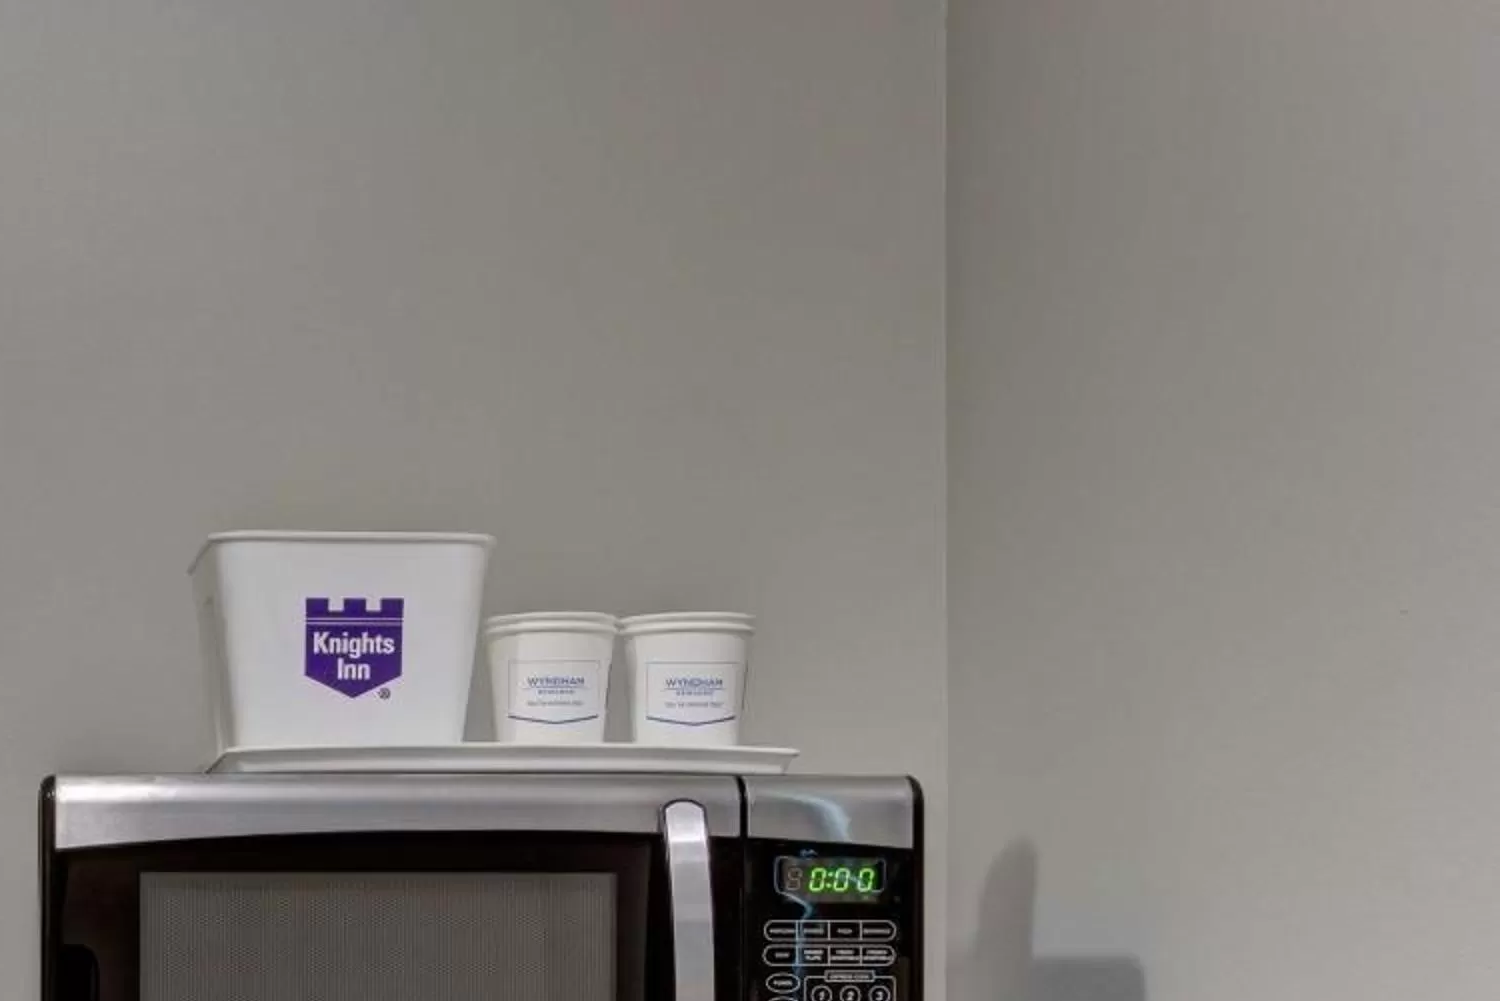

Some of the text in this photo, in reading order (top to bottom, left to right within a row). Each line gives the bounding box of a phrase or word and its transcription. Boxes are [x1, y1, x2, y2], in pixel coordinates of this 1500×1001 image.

[313, 631, 395, 659] Knights
[337, 657, 371, 680] Inn
[808, 866, 875, 893] 0:00
